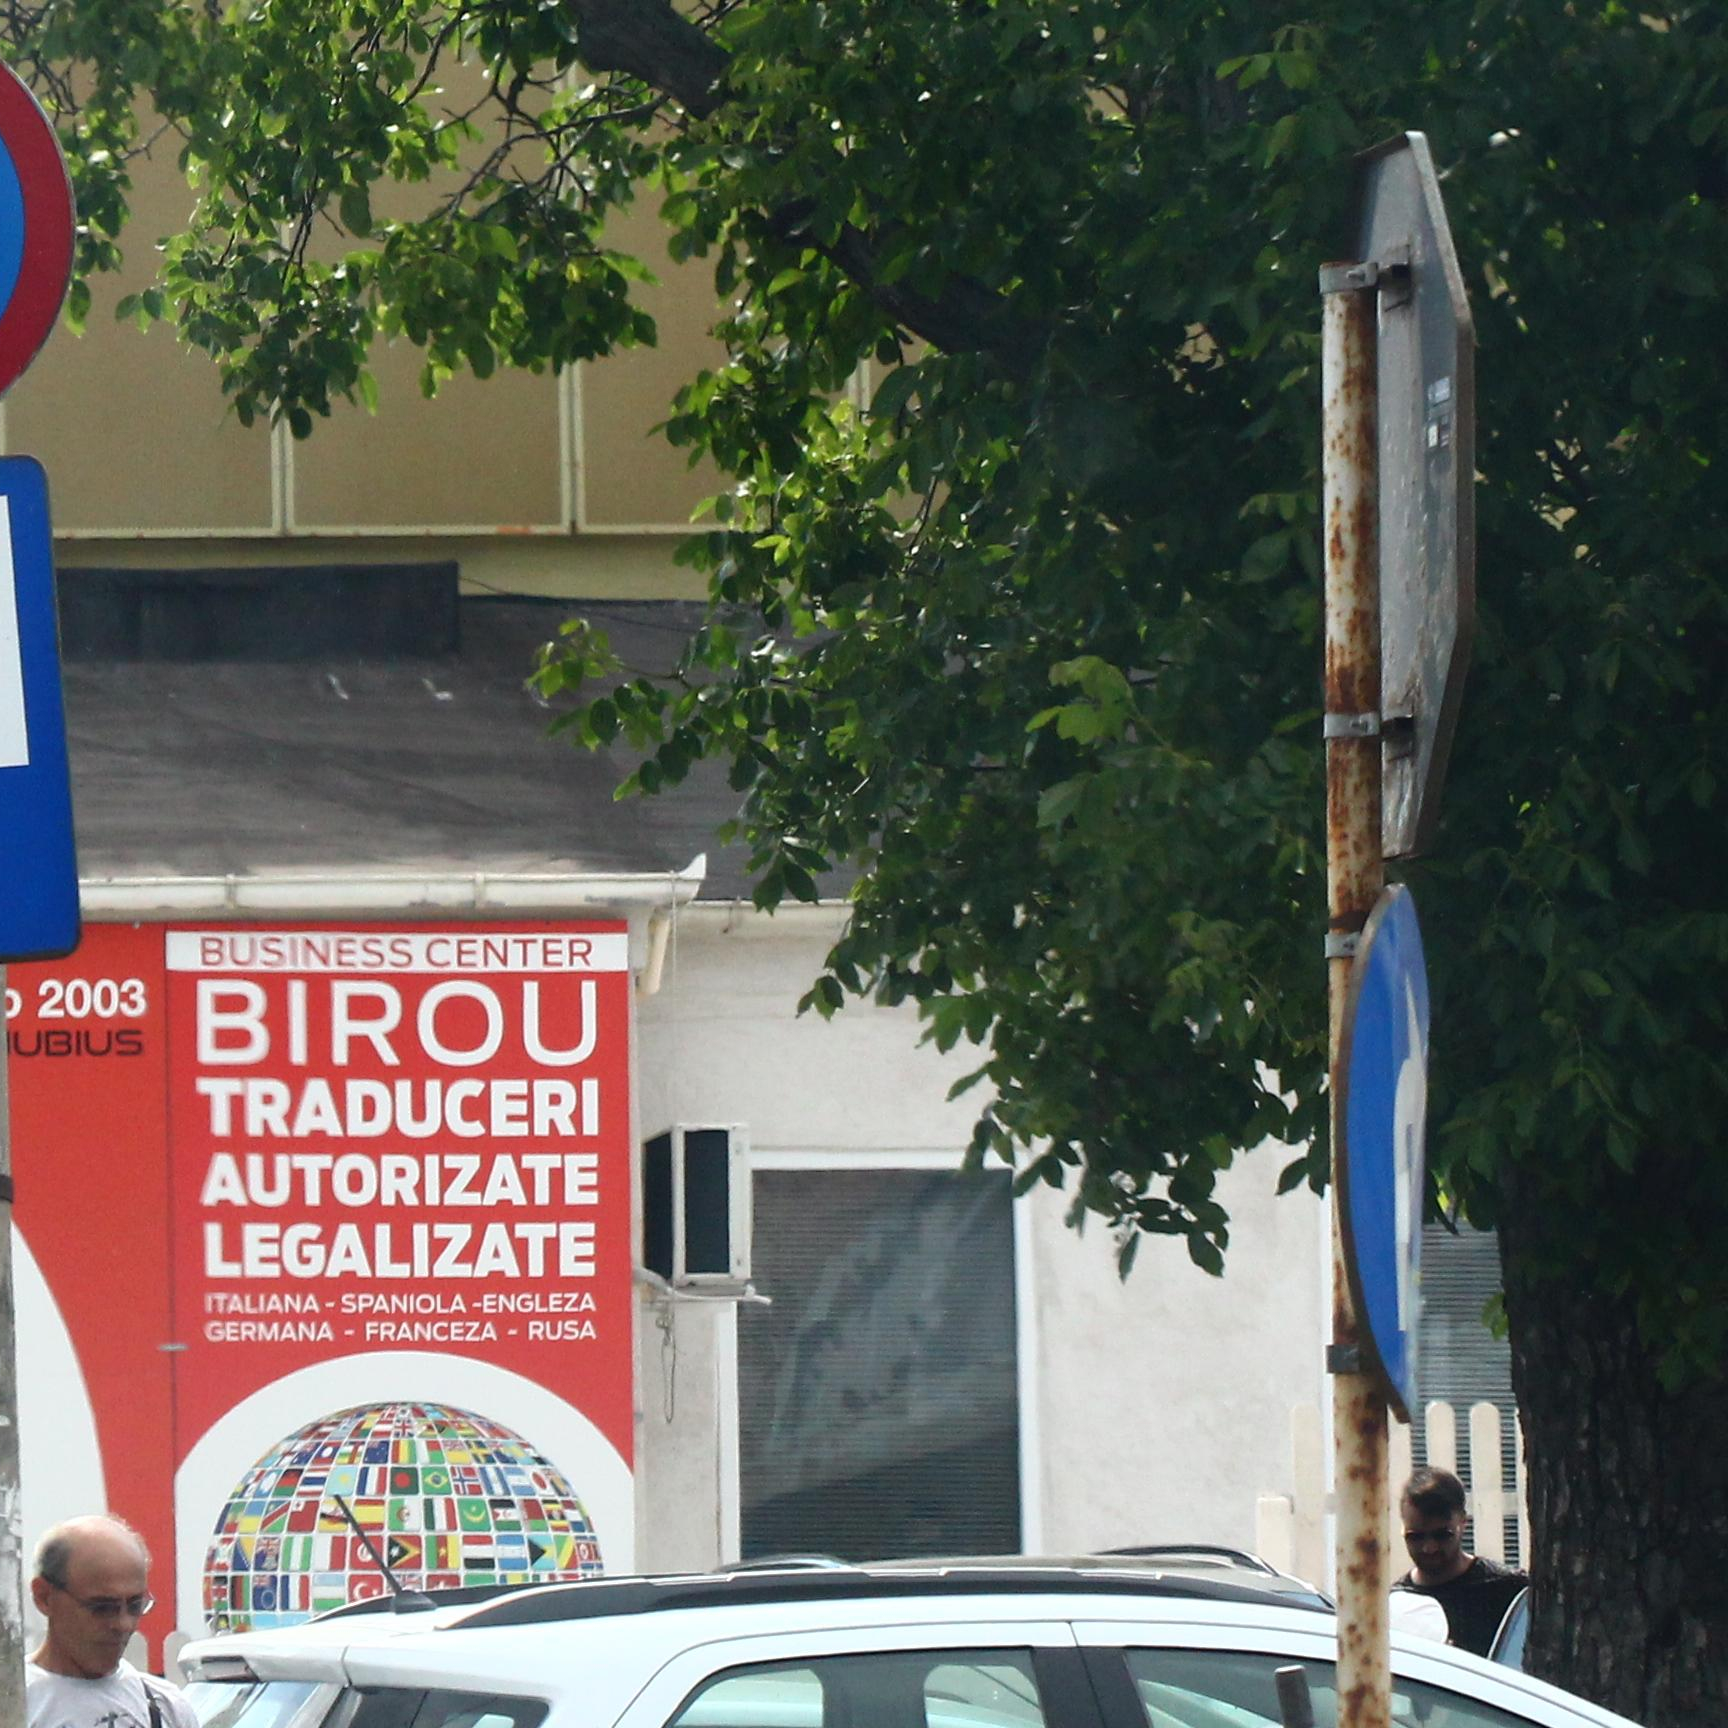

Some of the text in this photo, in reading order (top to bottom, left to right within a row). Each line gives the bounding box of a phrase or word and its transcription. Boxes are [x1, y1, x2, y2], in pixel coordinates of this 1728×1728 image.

[200, 937, 593, 968] BUSINESS CENTER
[38, 978, 147, 1019] 2003
[196, 978, 598, 1066] BIROU
[7, 1029, 143, 1057] UBIUS
[196, 1076, 599, 1138] TRADUCERI
[202, 1152, 599, 1207] AUTORIZATE
[203, 1221, 596, 1279] LEGALIZATE
[204, 1293, 320, 1315] ITALIANA
[341, 1292, 467, 1314] SPANIOLA
[204, 1320, 334, 1342] GERMANA
[365, 1320, 498, 1342] FRANCEZA
[528, 1319, 597, 1341] RUSA
